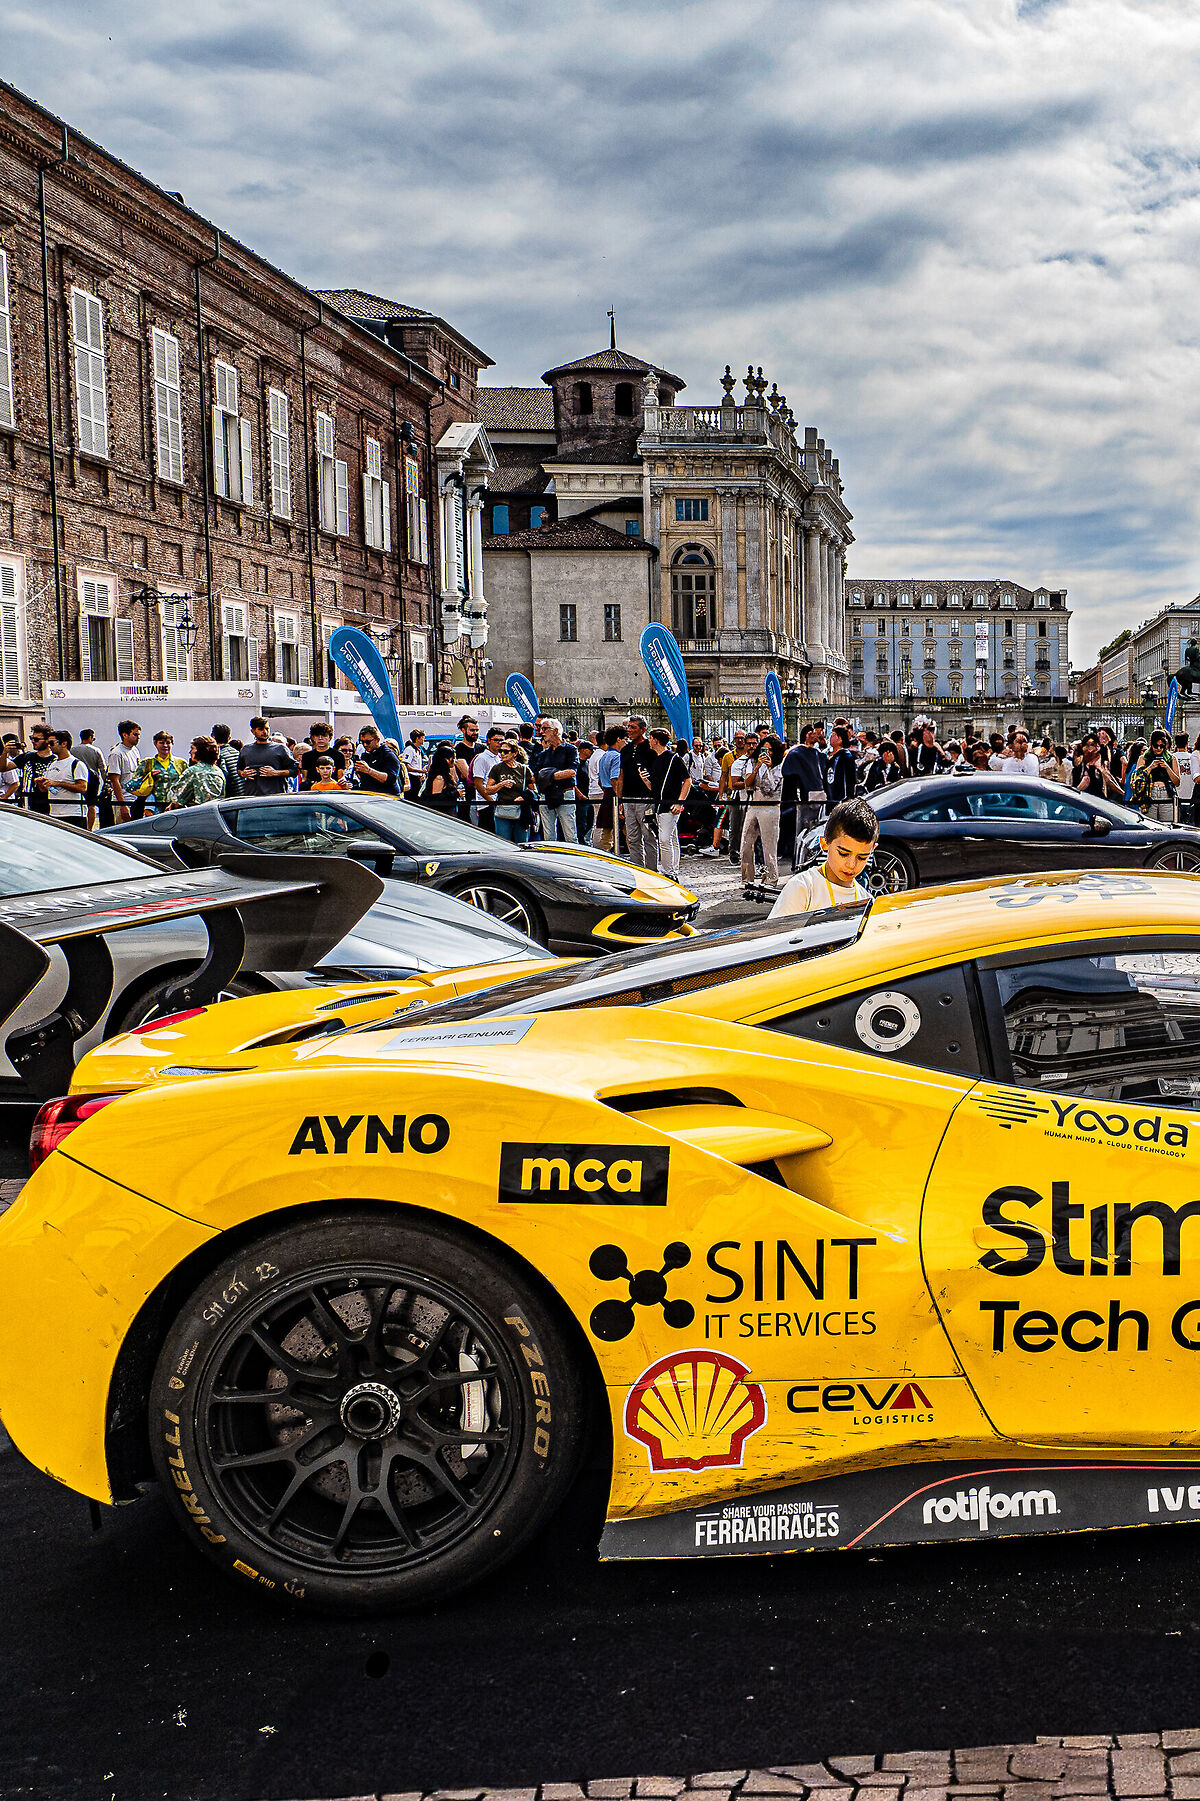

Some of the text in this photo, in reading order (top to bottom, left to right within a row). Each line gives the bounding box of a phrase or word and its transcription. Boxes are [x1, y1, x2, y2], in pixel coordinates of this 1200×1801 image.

[400, 1029, 516, 1043] FERRARI GENUINE
[288, 1114, 450, 1155] AYNO
[1050, 1100, 1188, 1148] Yooda
[1044, 1130, 1073, 1140] HUMAN
[1075, 1135, 1096, 1144] MIND
[1106, 1140, 1132, 1150] CLOUD
[1134, 1144, 1186, 1159] TECHNOLOGY
[521, 1157, 642, 1193] mca
[705, 1238, 877, 1304] SINT
[705, 1311, 877, 1338] IT SERVICES
[979, 1300, 1149, 1353] Tech
[182, 1341, 199, 1375] CHALLENGE
[853, 1414, 934, 1425] LOGISTICS
[164, 1410, 227, 1544] PIRELLI
[722, 1502, 814, 1519] SHARE YOUR PASSION
[695, 1511, 840, 1546] FERRARIRACES
